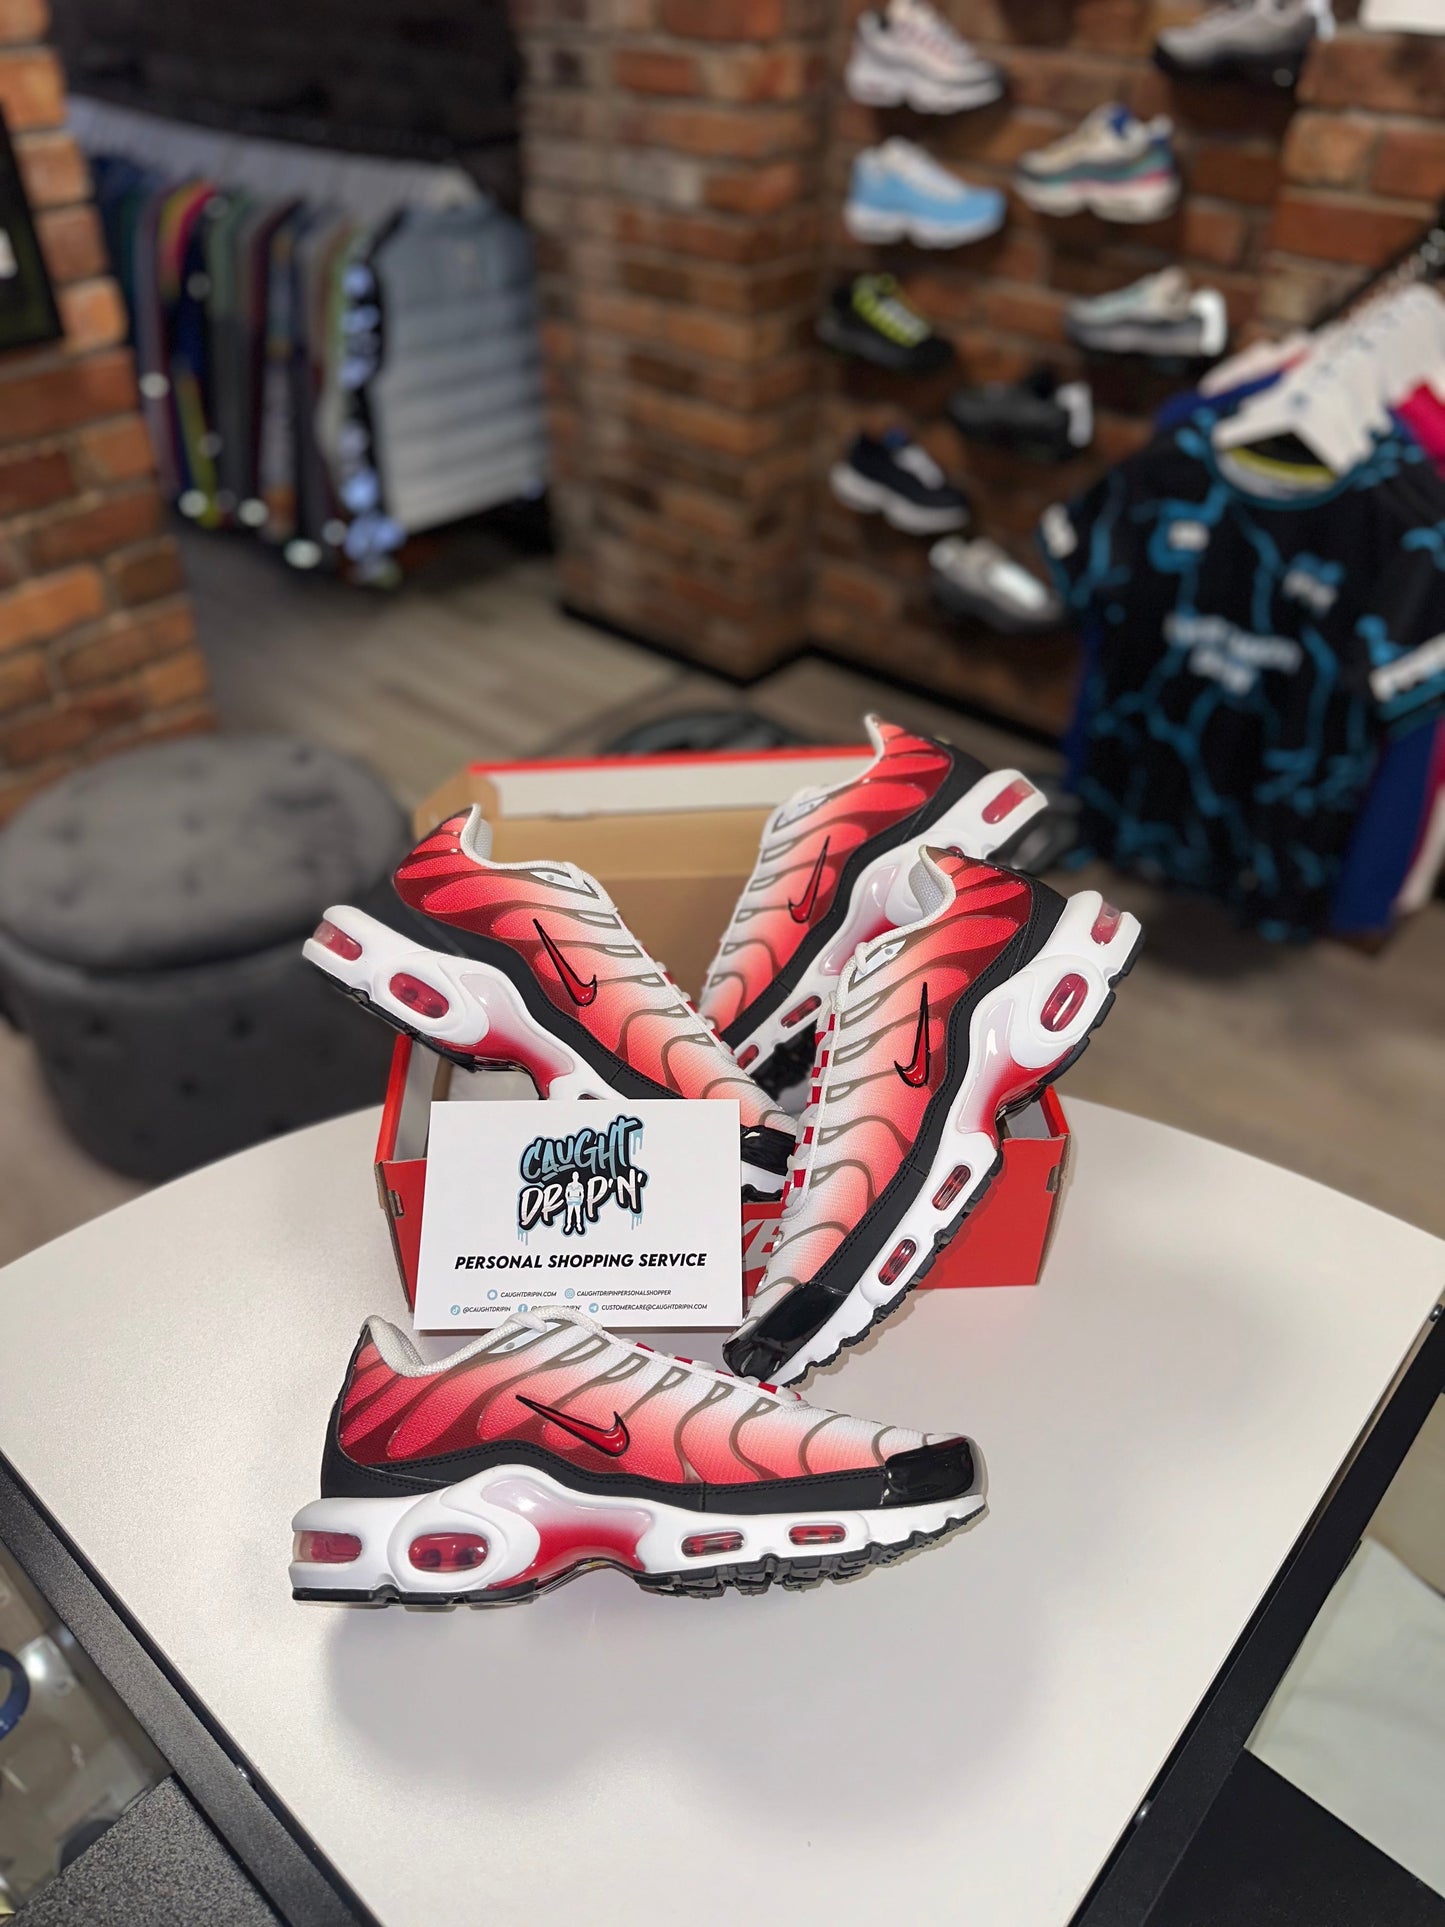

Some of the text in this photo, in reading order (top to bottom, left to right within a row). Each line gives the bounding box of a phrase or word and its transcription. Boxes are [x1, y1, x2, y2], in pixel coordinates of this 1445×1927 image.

[520, 1115, 642, 1182] CAUGHT
[455, 1253, 707, 1269] PERSONAL SHOPPING SERVICE
[576, 1289, 672, 1297] CAUGHTDRIPINPERSONALSHOPPER
[462, 1305, 512, 1314] @CAUGHTDRIPIN
[601, 1303, 708, 1312] CUSTOMERCARE@CAUGHTDRIPIN.COM
